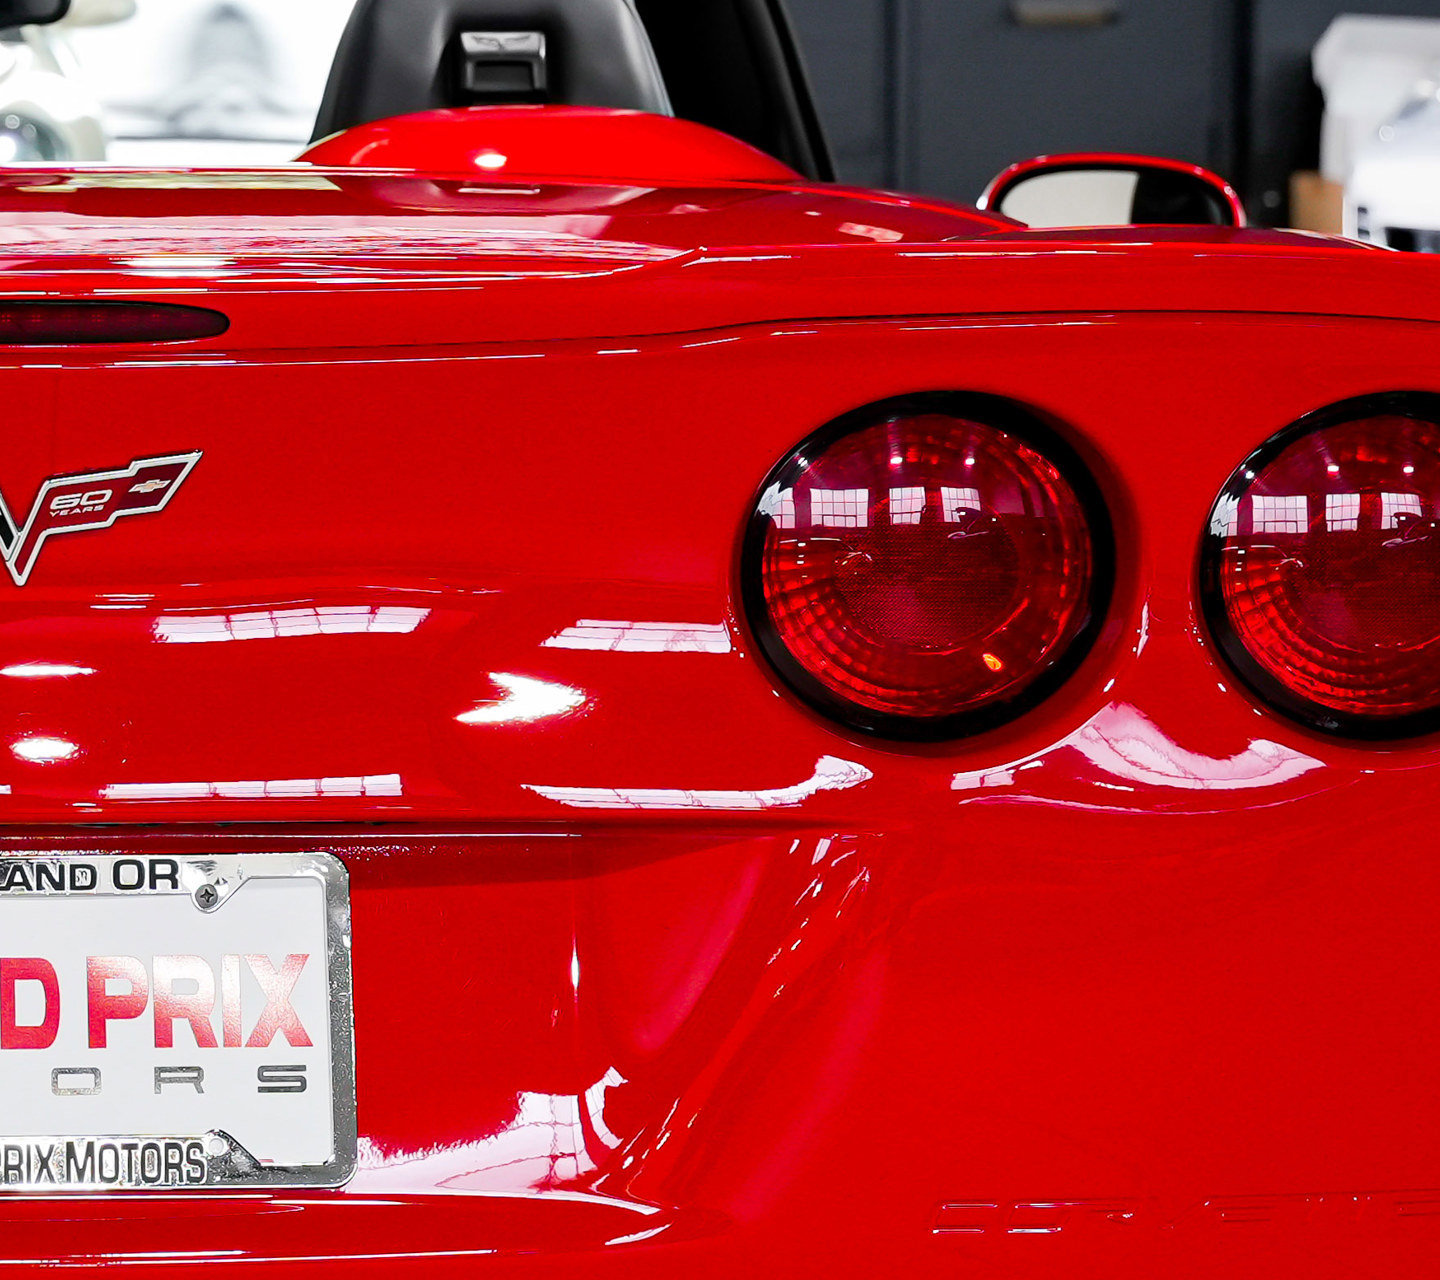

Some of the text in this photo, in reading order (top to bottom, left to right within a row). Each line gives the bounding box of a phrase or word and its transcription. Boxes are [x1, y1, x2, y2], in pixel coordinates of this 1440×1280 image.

[49, 505, 105, 517] YEARS
[50, 489, 113, 510] 60
[112, 859, 180, 891] OR
[86, 953, 314, 1049] PRIX
[65, 1140, 208, 1185] MOTORS
